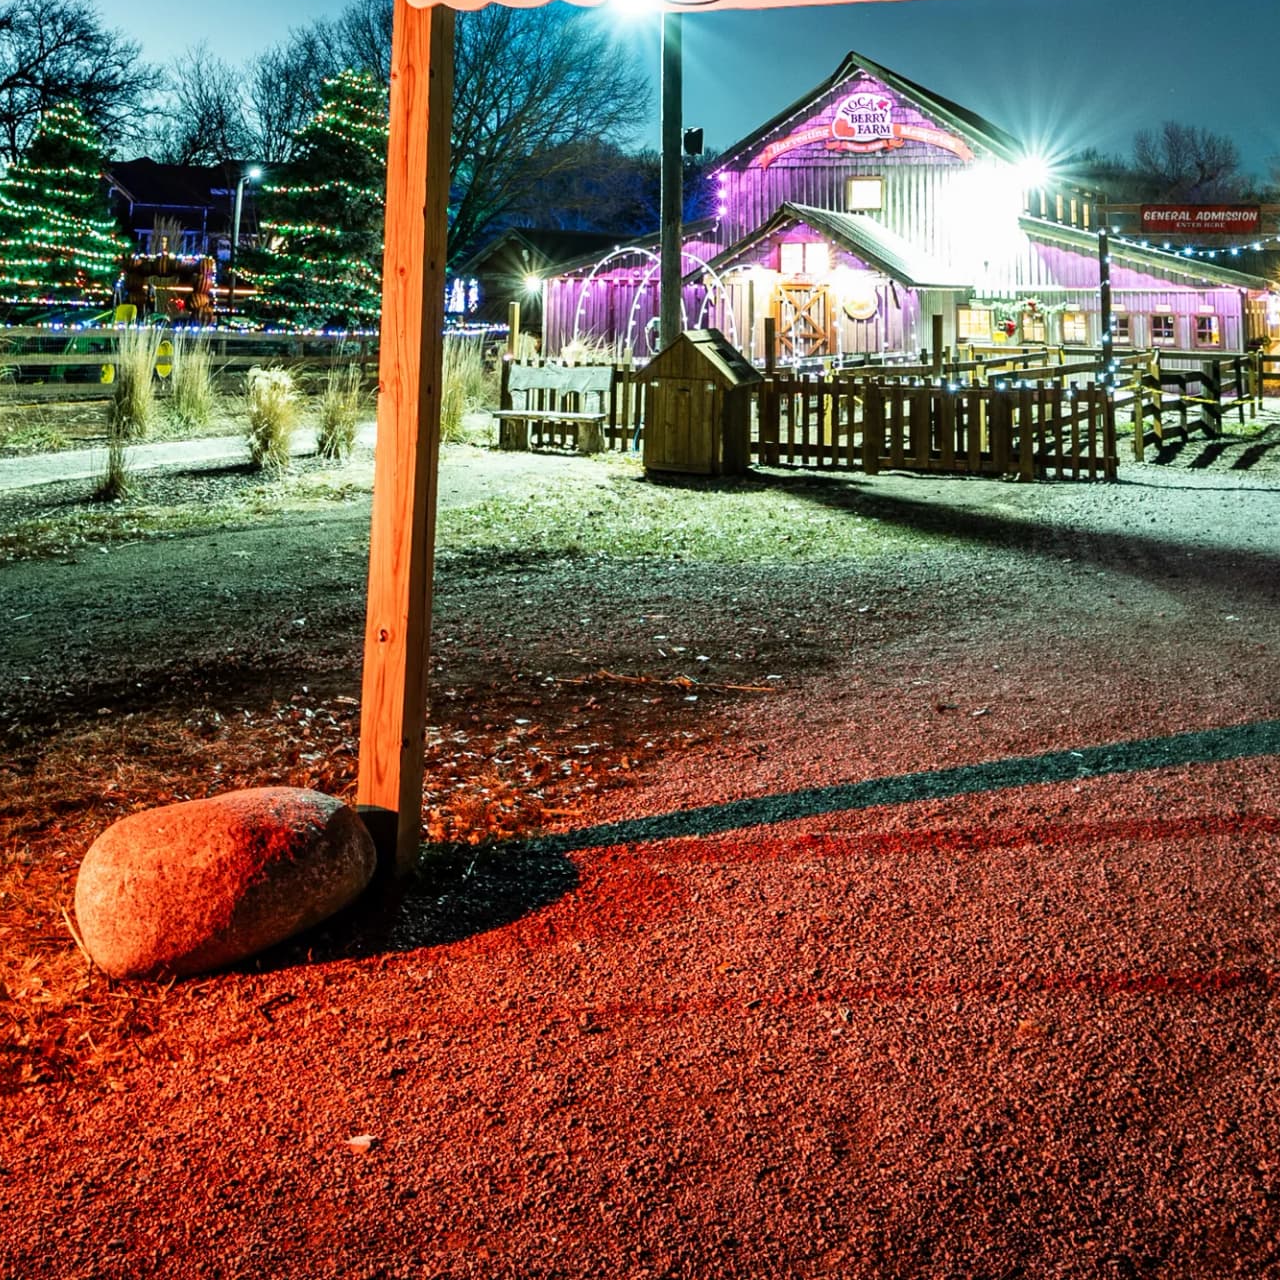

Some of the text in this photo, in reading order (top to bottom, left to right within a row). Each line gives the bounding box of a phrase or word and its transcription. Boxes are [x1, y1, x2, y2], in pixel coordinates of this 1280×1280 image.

[842, 97, 877, 116] ROCA
[851, 109, 888, 123] BERRY
[857, 124, 892, 136] FARM
[1144, 211, 1258, 221] GENERAL ADMISSION
